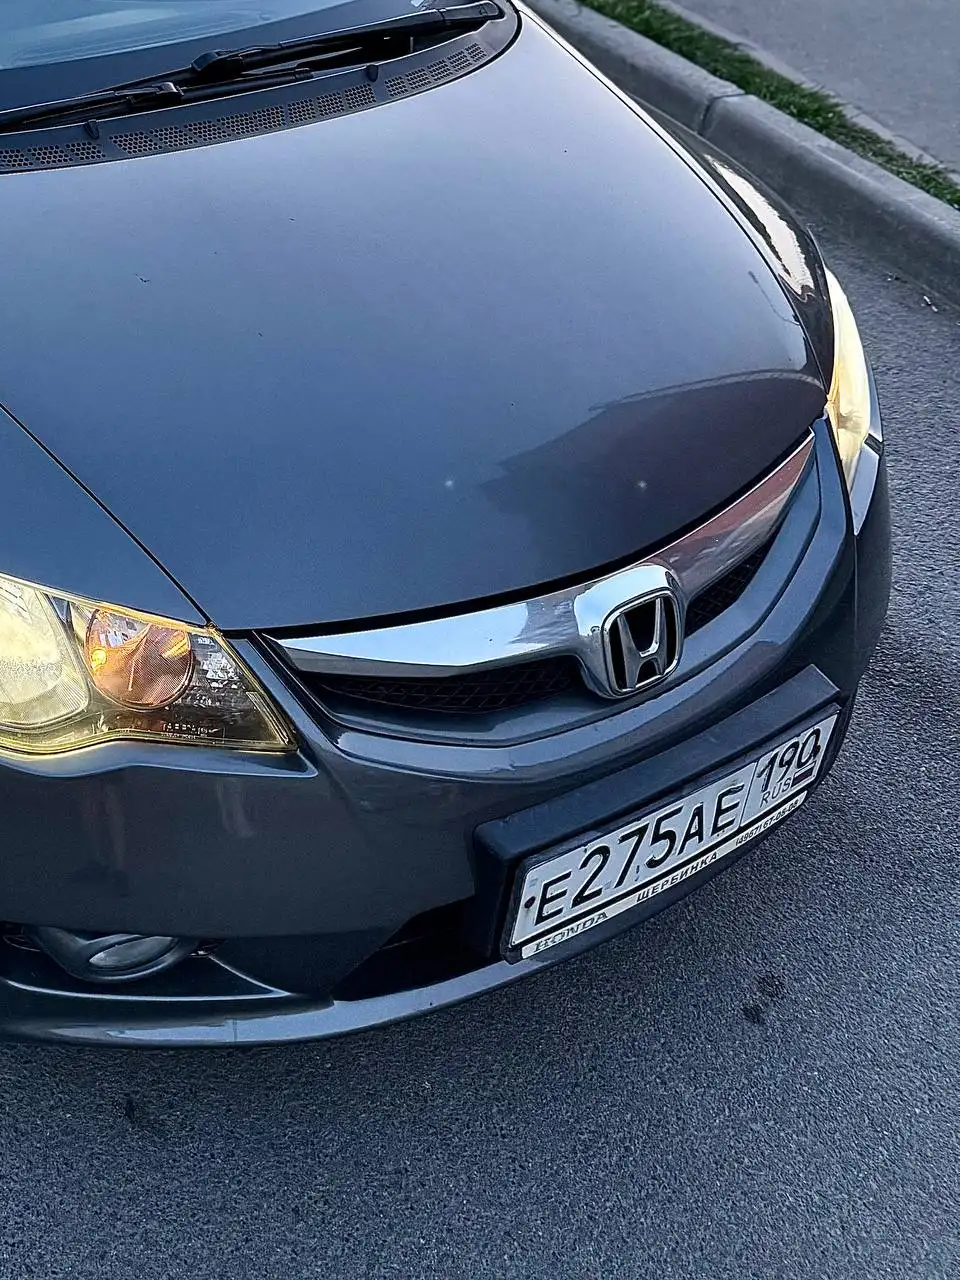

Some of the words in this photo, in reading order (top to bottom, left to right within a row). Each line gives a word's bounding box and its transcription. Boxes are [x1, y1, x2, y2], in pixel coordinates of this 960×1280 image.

[757, 728, 822, 793] 190
[760, 779, 791, 808] RUS
[534, 911, 608, 952] HONDA
